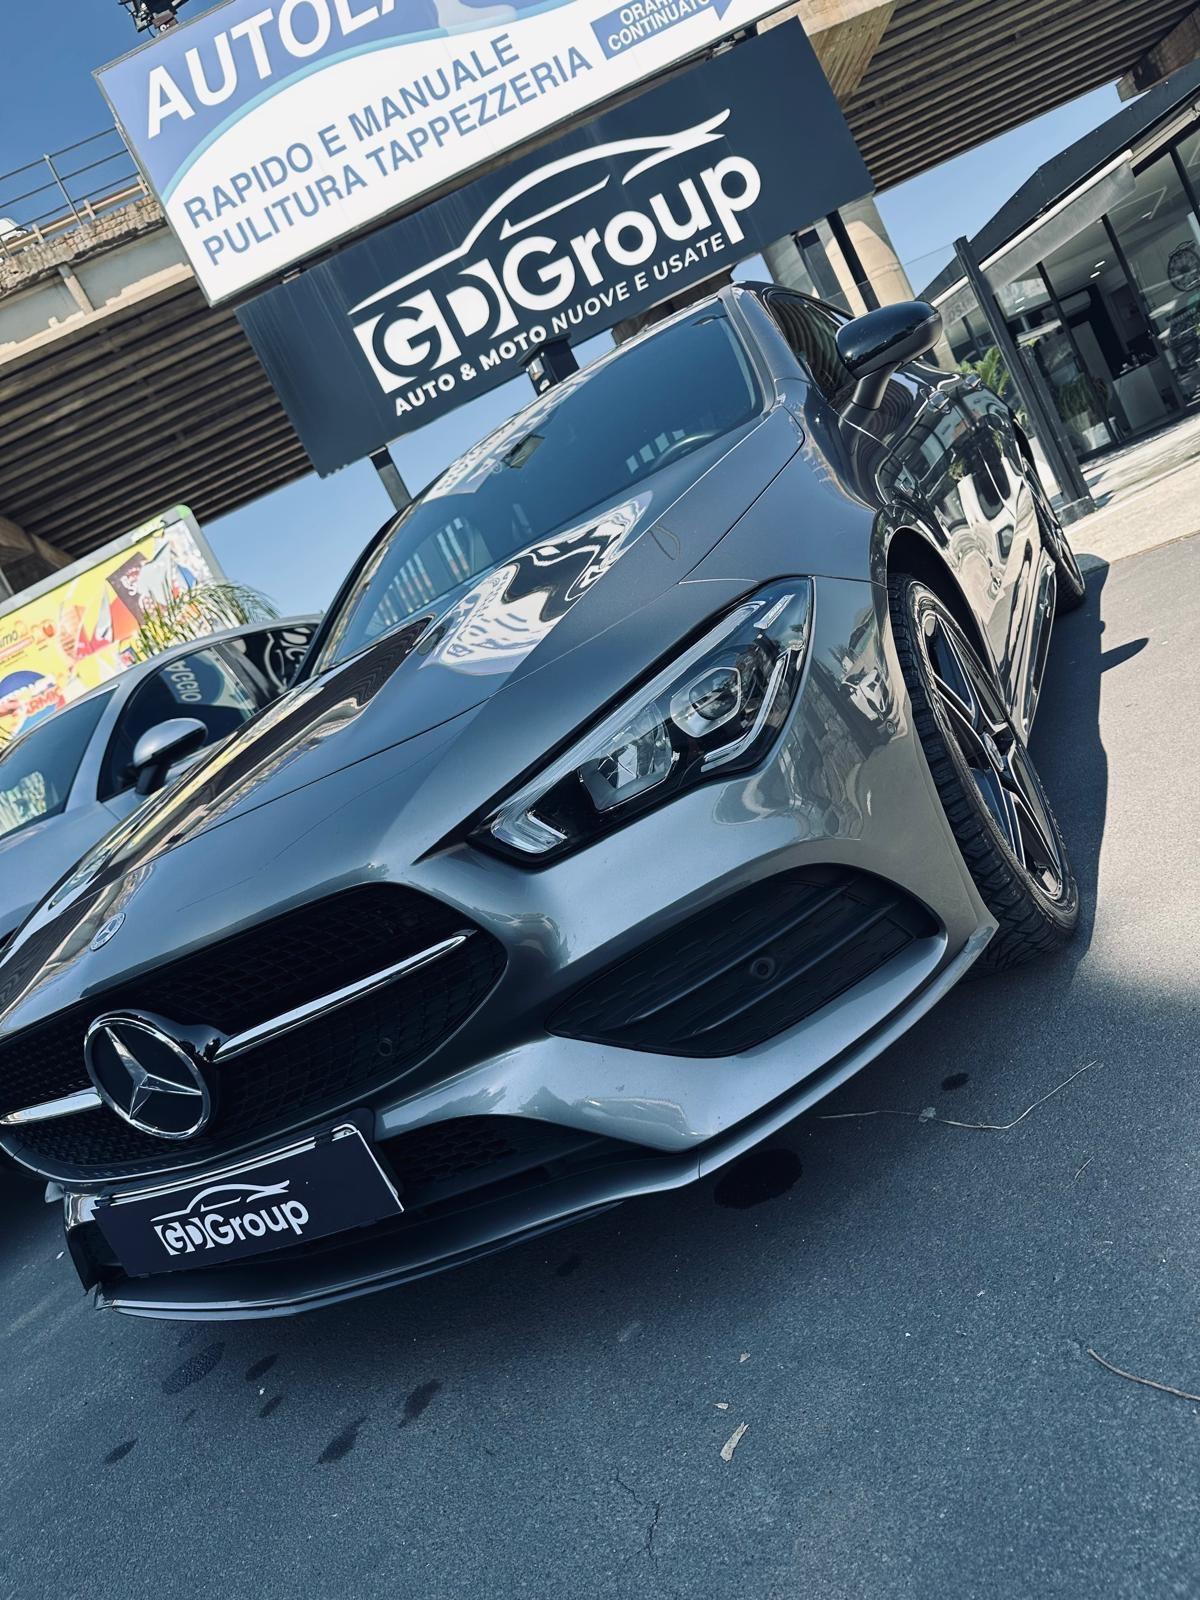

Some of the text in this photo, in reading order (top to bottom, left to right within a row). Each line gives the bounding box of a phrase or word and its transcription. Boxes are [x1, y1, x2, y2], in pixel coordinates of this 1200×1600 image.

[148, 0, 395, 138] AUTOL
[183, 33, 520, 229] RAPIDO E MANUALE
[202, 46, 593, 266] PULITURA TAPPEZZERIA
[394, 233, 725, 416] AUTO & MOTO NUOVE E USATE
